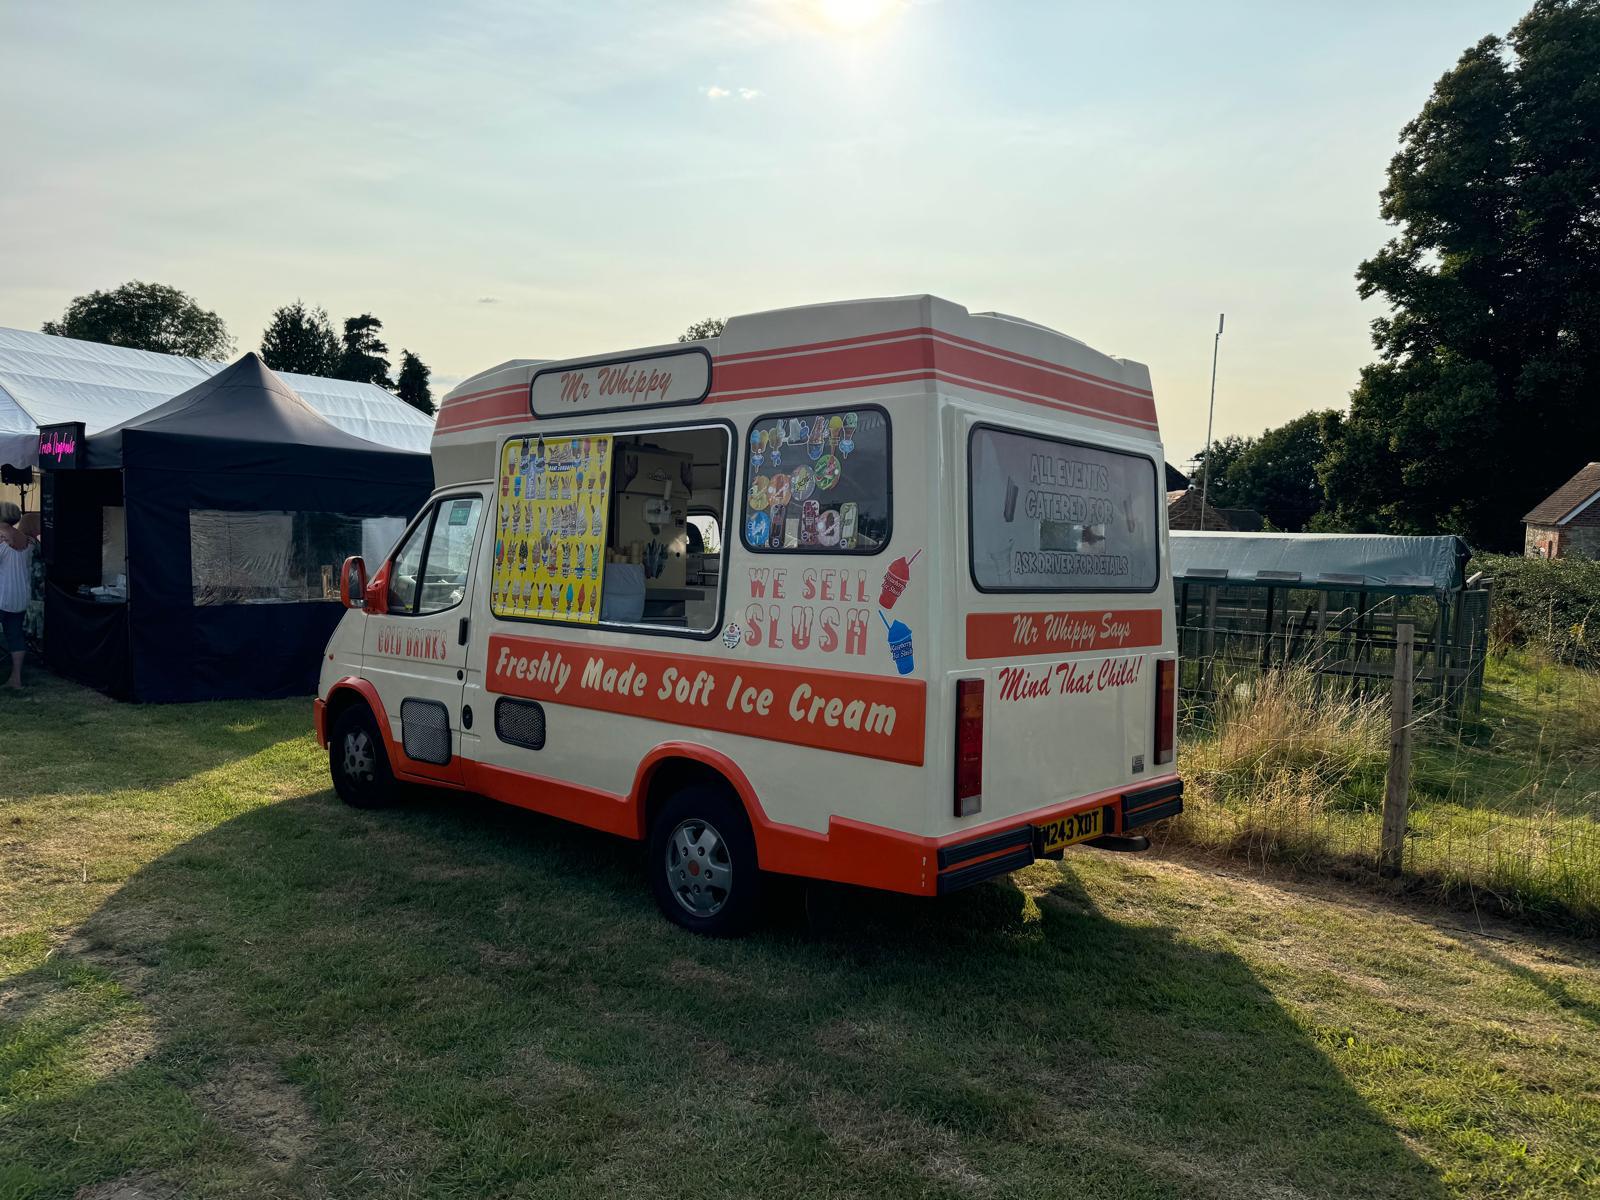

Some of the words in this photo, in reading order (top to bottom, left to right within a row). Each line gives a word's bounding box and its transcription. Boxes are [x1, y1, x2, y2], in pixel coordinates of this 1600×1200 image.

[560, 372, 591, 403] Mr
[597, 364, 673, 403] Whippy
[1029, 453, 1057, 486] ALL
[1056, 457, 1110, 493] EVENTS
[1024, 489, 1088, 525] CATERED
[1087, 496, 1114, 525] FOR
[1014, 551, 1038, 575] ASK
[1037, 552, 1074, 576] DRIVER
[1073, 553, 1093, 576] FOR
[1093, 554, 1129, 577] DETAILS
[748, 567, 788, 599] WE
[802, 567, 871, 603] SELL
[378, 625, 402, 656] COLD
[405, 626, 448, 661] DRINKS
[744, 602, 871, 655] SLUSH
[1012, 613, 1039, 646] Mr
[1043, 612, 1097, 649] Whippy
[1099, 611, 1131, 646] Says
[495, 646, 572, 695] Freshly
[580, 656, 648, 697] Made
[657, 666, 715, 707] Soft
[726, 674, 774, 716] Ice
[788, 682, 897, 737] Cream
[998, 664, 1053, 702] Mind
[1055, 661, 1095, 695] That
[1097, 654, 1143, 692] Child!
[1075, 811, 1099, 837] XDT
